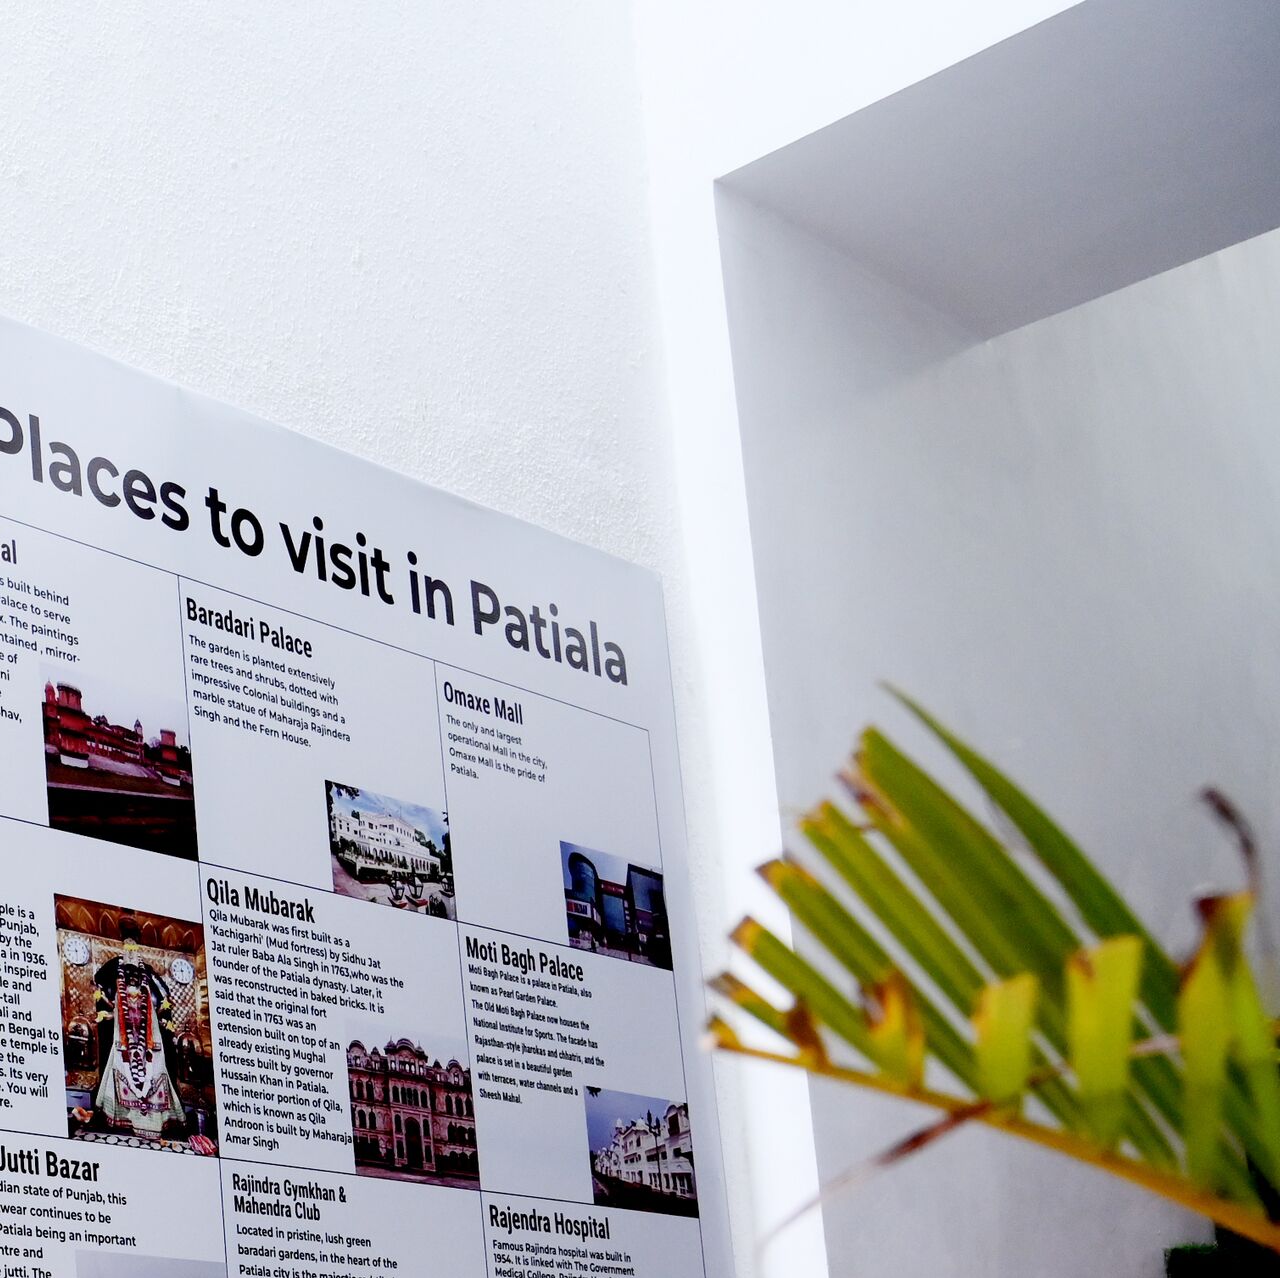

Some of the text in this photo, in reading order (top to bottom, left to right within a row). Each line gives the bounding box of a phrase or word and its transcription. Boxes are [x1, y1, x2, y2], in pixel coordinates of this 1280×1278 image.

[7, 577, 31, 594] built
[33, 586, 69, 606] behind
[204, 486, 264, 557] to
[278, 515, 394, 605] visit
[406, 550, 454, 626] in
[470, 579, 628, 686] Patiala
[186, 597, 312, 658] Baradari Palace
[188, 634, 335, 690] The garden is planted extensively
[443, 681, 523, 725] Omaxe Mall
[206, 878, 315, 923] Qila Mubarak
[9, 948, 19, 961] in
[22, 951, 48, 966] 1936.
[465, 935, 583, 982] Moti Bagh Palace
[224, 1116, 352, 1145] Androon is built by Maharaja
[45, 1150, 100, 1181] Bazar
[232, 1173, 346, 1203] Rajindra Gymkhan &
[233, 1195, 320, 1221] Mahendra Club
[489, 1204, 610, 1242] Rajendra Hospital
[236, 1224, 273, 1237] Located
[275, 1227, 284, 1238] in
[325, 1232, 344, 1244] lush
[345, 1237, 371, 1247] green
[22, 1247, 43, 1258] and
